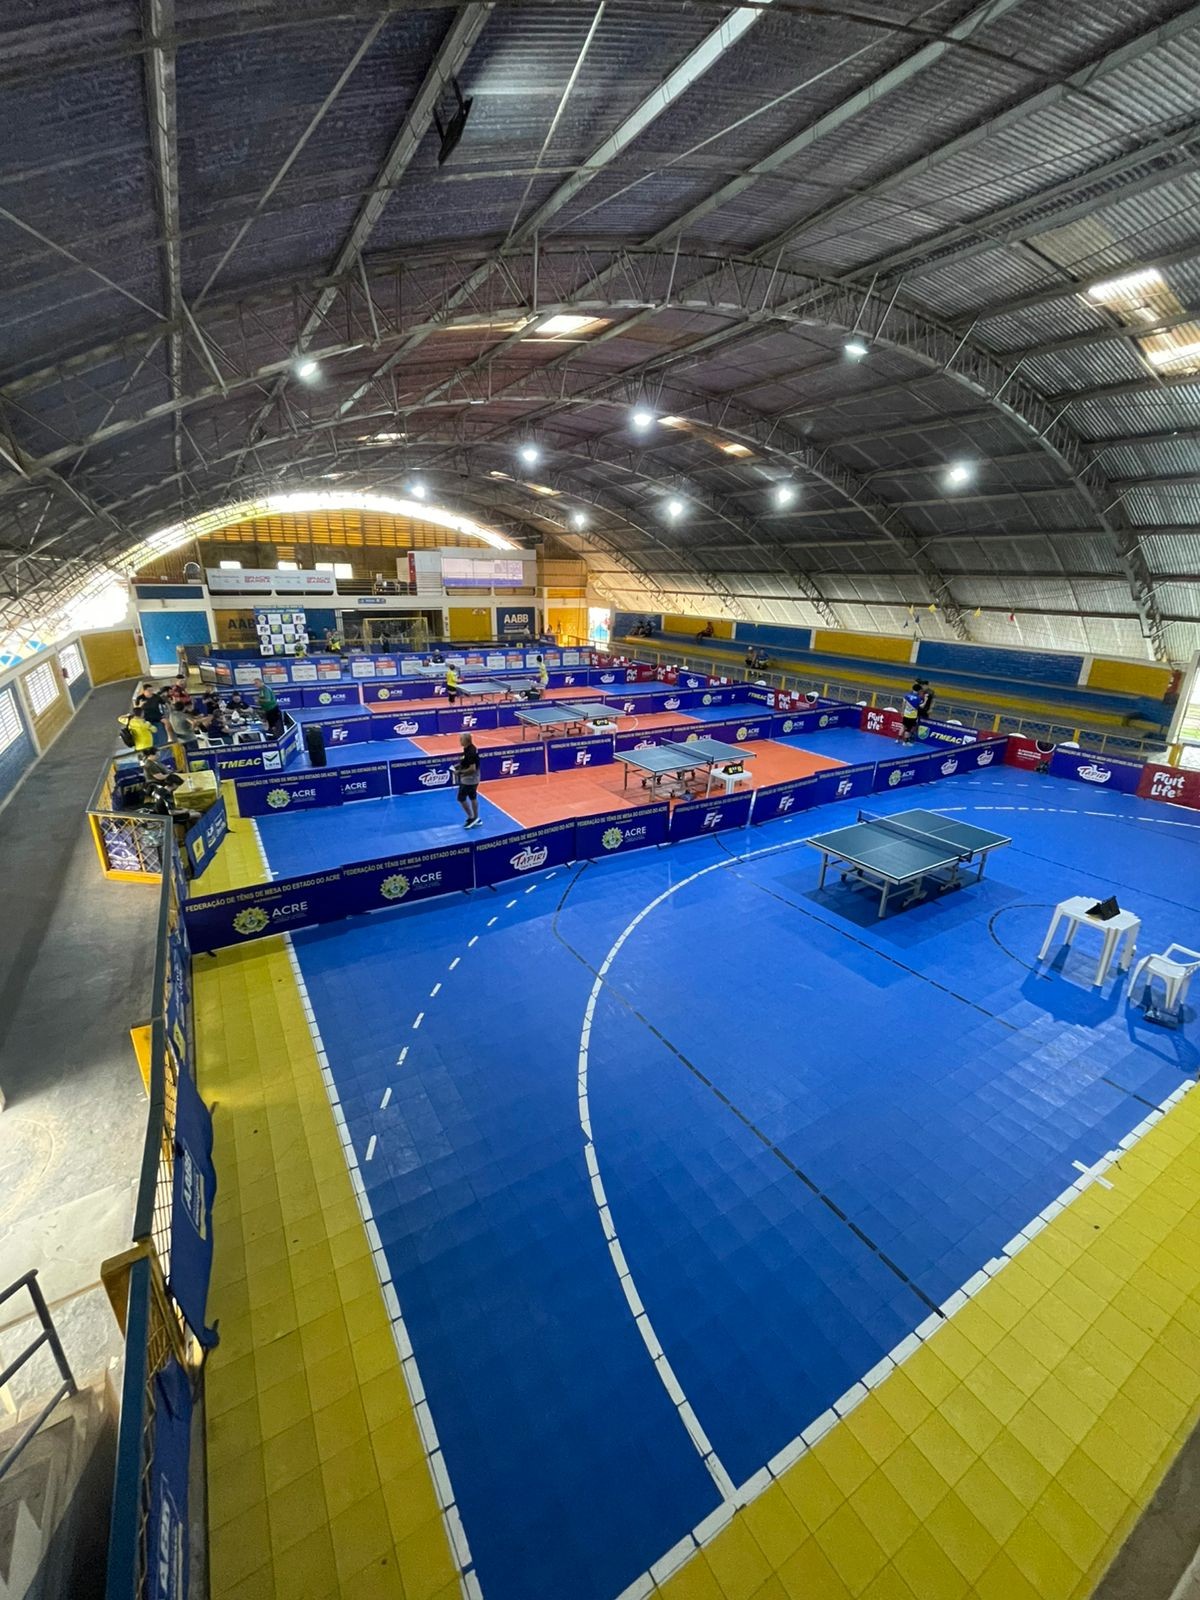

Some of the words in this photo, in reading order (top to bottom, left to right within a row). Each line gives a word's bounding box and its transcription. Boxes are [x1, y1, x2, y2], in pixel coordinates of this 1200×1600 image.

[228, 618, 255, 629] AAB
[504, 614, 528, 624] AABB
[930, 731, 962, 744] FTMEAC
[218, 757, 261, 769] TMEAC
[344, 781, 367, 791] ACRE
[291, 788, 316, 799] ACRE
[625, 826, 647, 837] ACRE
[513, 851, 546, 867] TAPIRI
[412, 871, 442, 885] ACRE
[185, 898, 225, 912] FEDERAÇÃO
[237, 892, 254, 902] TÊNIS
[255, 889, 264, 898] DE
[265, 887, 282, 895] MESA
[283, 884, 291, 892] DO
[293, 879, 315, 890] ESTADO
[316, 877, 325, 885] DO
[326, 874, 340, 882] ACRE
[272, 901, 308, 917] ACRE
